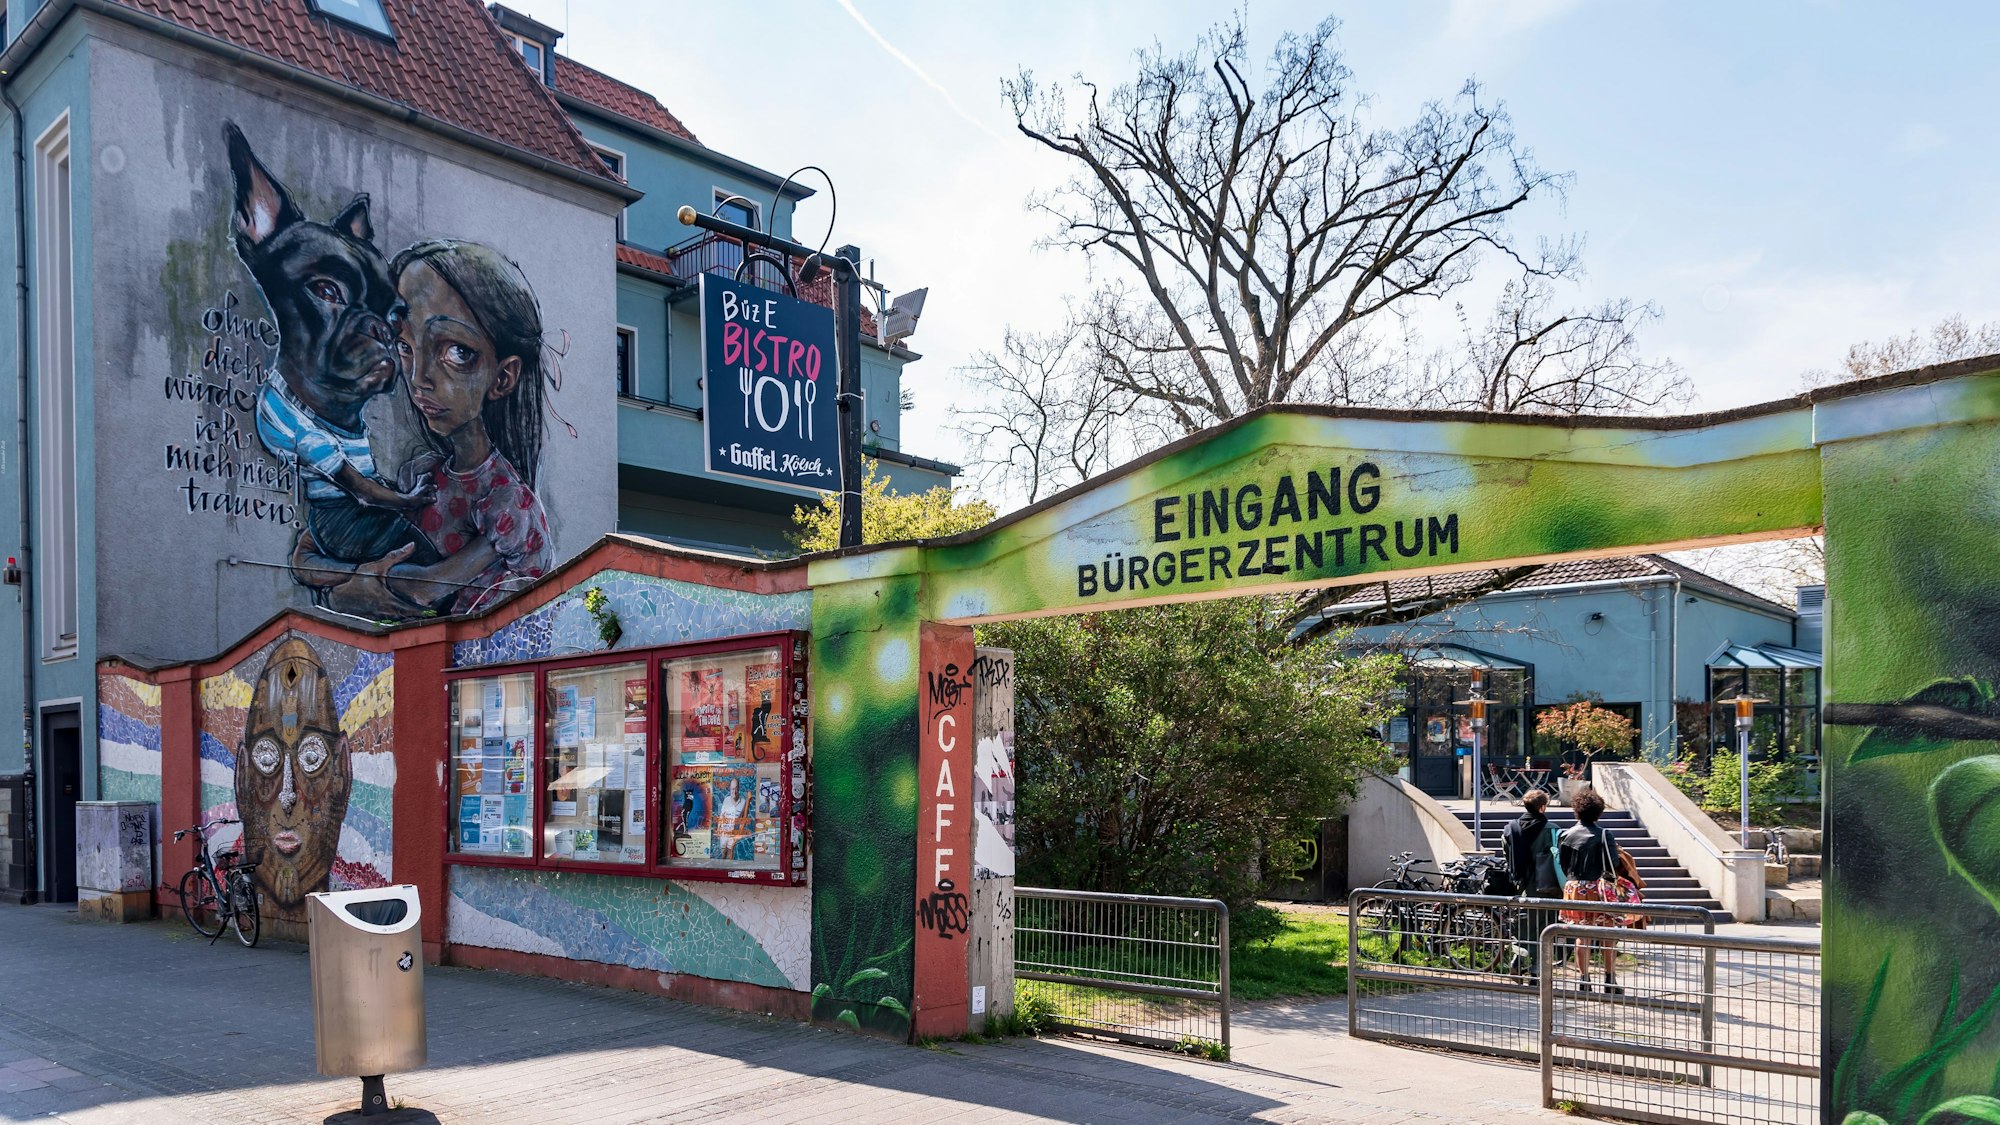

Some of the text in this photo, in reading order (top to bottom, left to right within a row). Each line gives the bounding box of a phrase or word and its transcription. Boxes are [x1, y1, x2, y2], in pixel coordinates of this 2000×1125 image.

[202, 289, 280, 348] ohne
[203, 336, 269, 386] dich
[723, 322, 821, 381] BISTRO
[164, 374, 259, 413] würde
[195, 408, 253, 451] ich
[165, 442, 240, 479] mich
[730, 442, 825, 477] Gaffel Kölsch
[1154, 462, 1381, 543] EINGANG
[1078, 513, 1459, 597] BÜRGERZENTRUM
